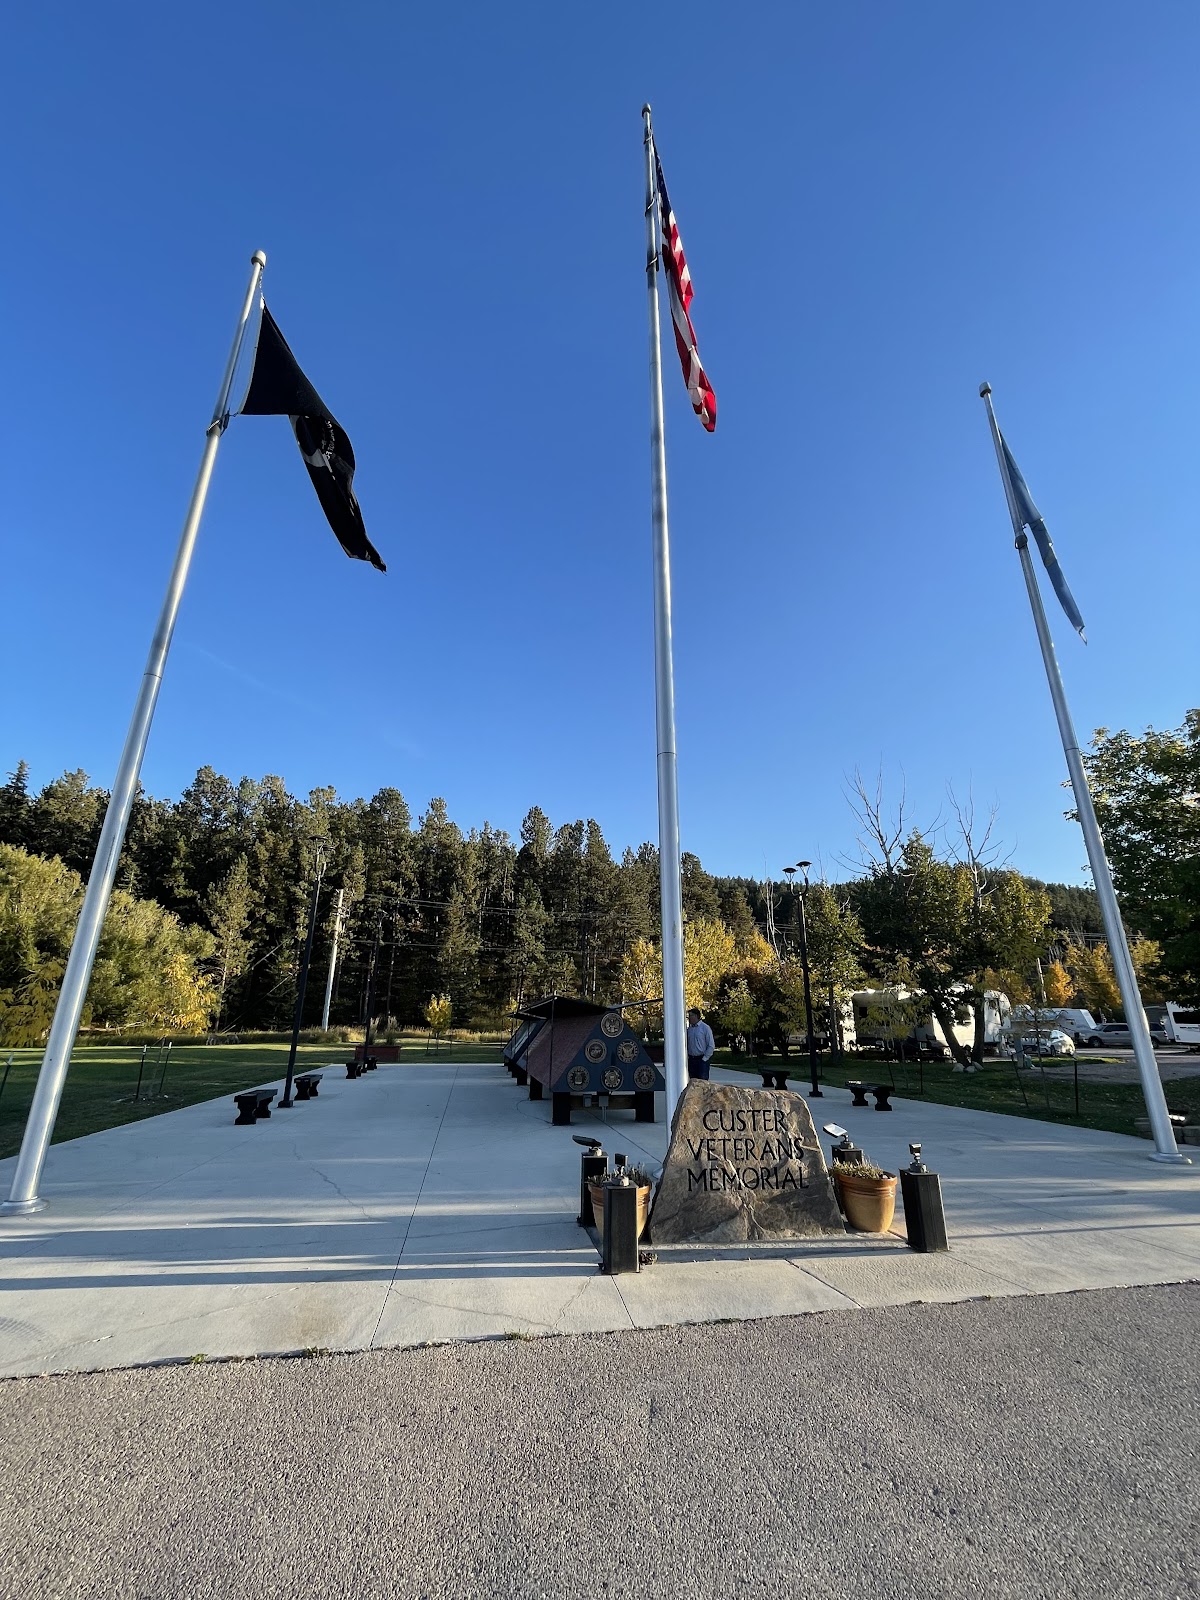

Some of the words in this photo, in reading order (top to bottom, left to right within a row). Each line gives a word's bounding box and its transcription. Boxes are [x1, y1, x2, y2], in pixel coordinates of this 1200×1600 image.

[703, 1109, 788, 1131] CUSTER
[687, 1138, 805, 1161] VETERANS
[687, 1167, 810, 1191] MEMORIAL
